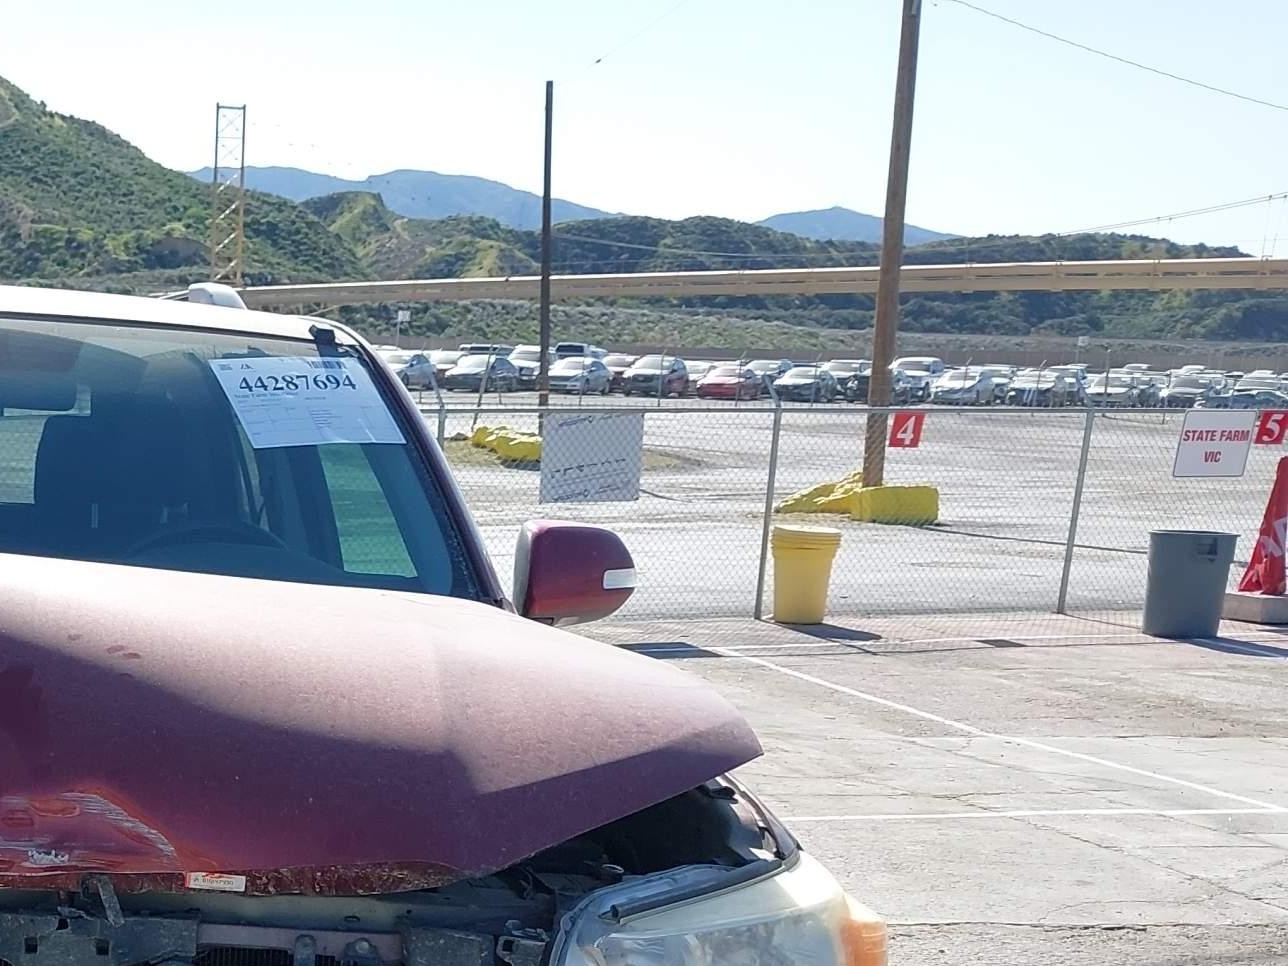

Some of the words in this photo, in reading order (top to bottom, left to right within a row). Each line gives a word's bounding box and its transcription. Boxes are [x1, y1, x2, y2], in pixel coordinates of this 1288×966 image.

[239, 374, 357, 392] 44287694
[896, 415, 915, 445] 4
[1183, 429, 1217, 442] STATE
[1219, 429, 1250, 442] FARM
[1262, 413, 1285, 442] 5
[1204, 451, 1222, 463] VIC
